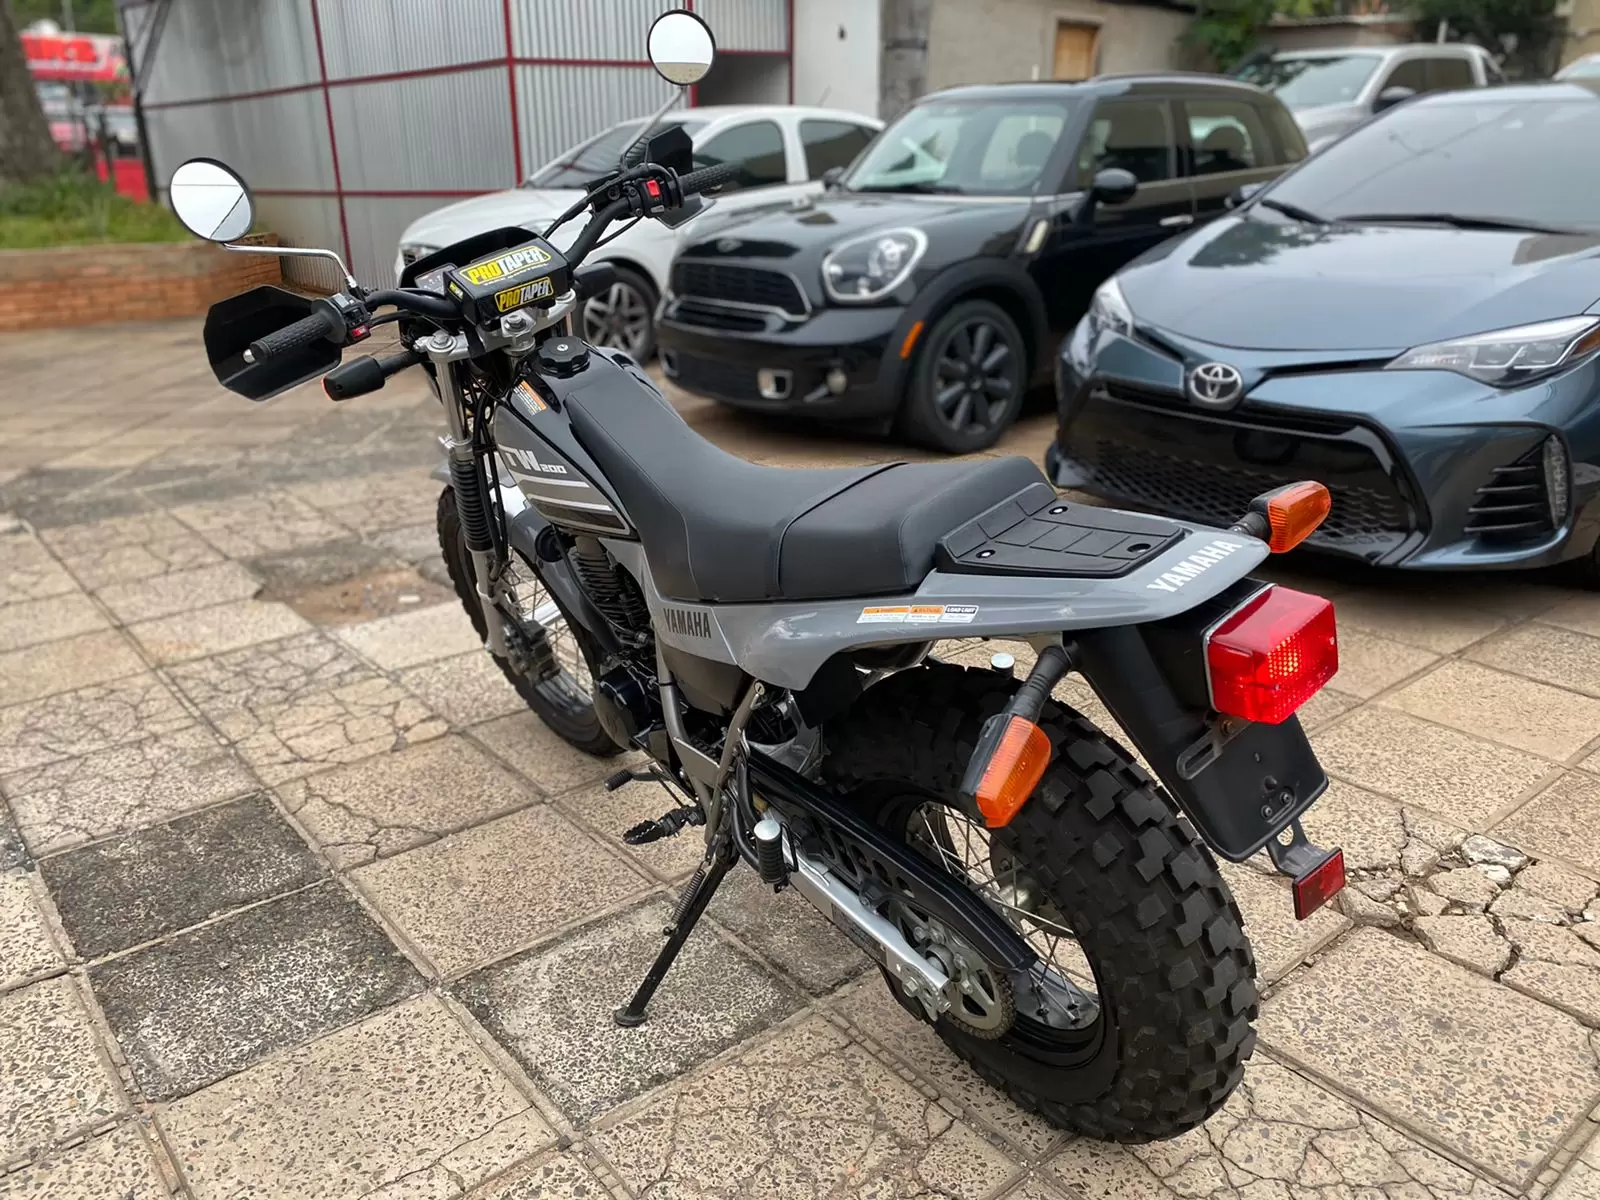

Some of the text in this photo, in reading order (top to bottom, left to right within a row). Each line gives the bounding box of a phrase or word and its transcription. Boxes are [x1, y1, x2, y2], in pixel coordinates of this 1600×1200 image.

[467, 248, 544, 284] PROTAPER
[500, 279, 550, 309] PROTAPER
[497, 444, 568, 474] TW 200
[1146, 540, 1243, 593] YAMAHA
[663, 607, 711, 639] YAMAHA
